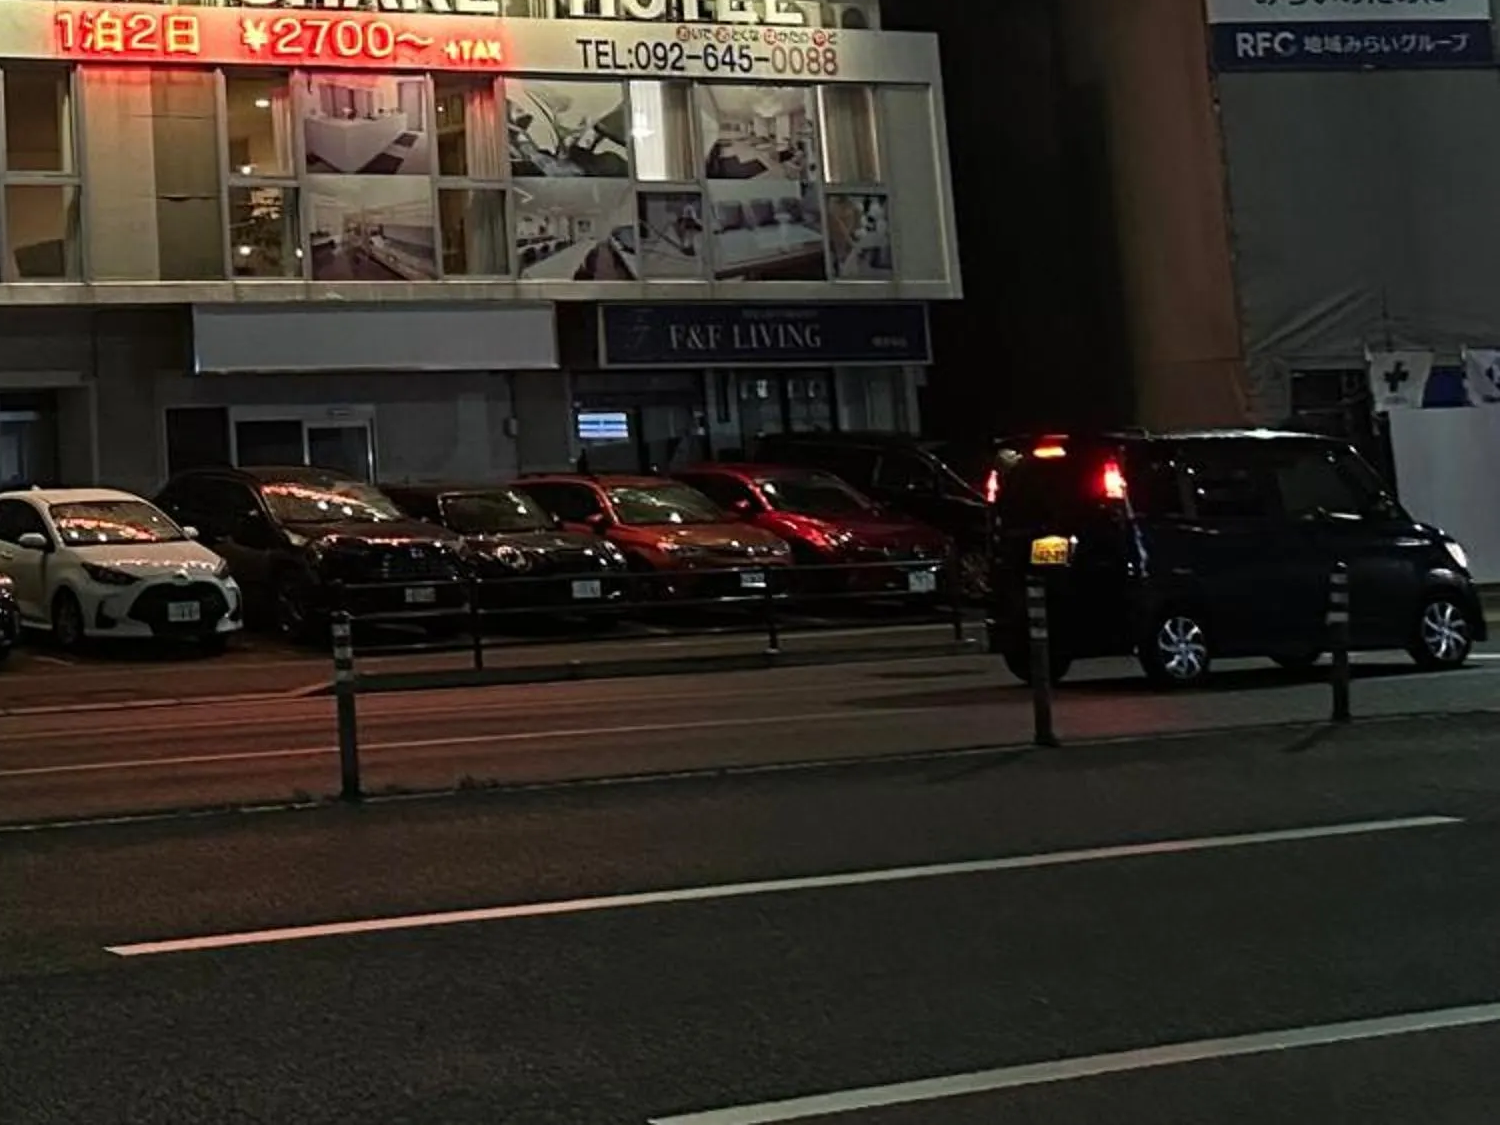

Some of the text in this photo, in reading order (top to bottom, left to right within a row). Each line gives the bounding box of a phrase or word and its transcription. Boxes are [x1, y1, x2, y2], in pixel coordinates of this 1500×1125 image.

[54, 11, 200, 55] 1泊2日
[443, 38, 503, 64] +TAX
[1236, 32, 1470, 58] RFC 地域みらいグループ
[576, 39, 839, 76] TEL:092-645-0088
[733, 323, 822, 350] LIVING
